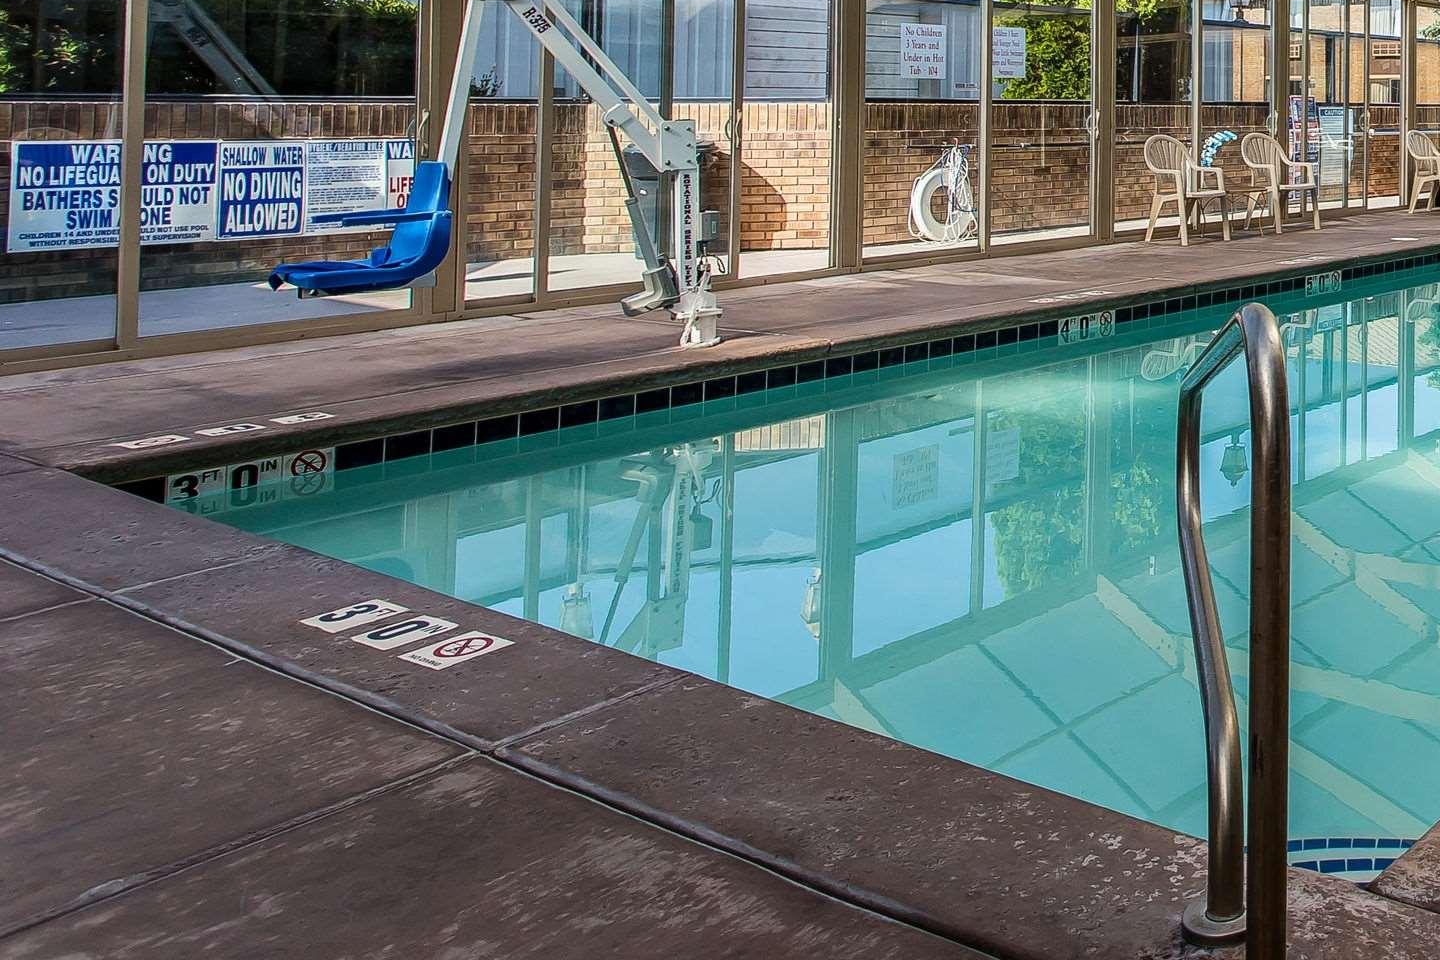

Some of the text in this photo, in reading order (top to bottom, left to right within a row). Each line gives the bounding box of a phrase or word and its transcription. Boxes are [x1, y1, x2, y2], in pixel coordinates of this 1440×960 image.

[905, 26, 943, 38] No Children
[906, 40, 939, 50] 3 Years and
[903, 52, 944, 63] Under in Hot
[910, 65, 921, 75] Tub
[71, 144, 172, 164] WARNG
[223, 146, 267, 166] SHALLOW
[273, 145, 303, 165] WATER
[20, 163, 214, 187] NO LIFEGUA ON DUTY
[224, 172, 246, 200] NO
[250, 171, 302, 200] DIVING
[23, 186, 210, 211] BATHERS SULD NOT
[683, 173, 692, 225] ROTATIONAL
[65, 209, 113, 230] SWIM
[225, 202, 298, 232] ALLOWED
[19, 231, 60, 240] CHILDREN
[684, 229, 692, 260] SERIES
[1061, 319, 1070, 332] 4
[172, 459, 278, 499] 3 FT 0 IN
[319, 604, 379, 622] 3
[367, 620, 430, 640] 0
